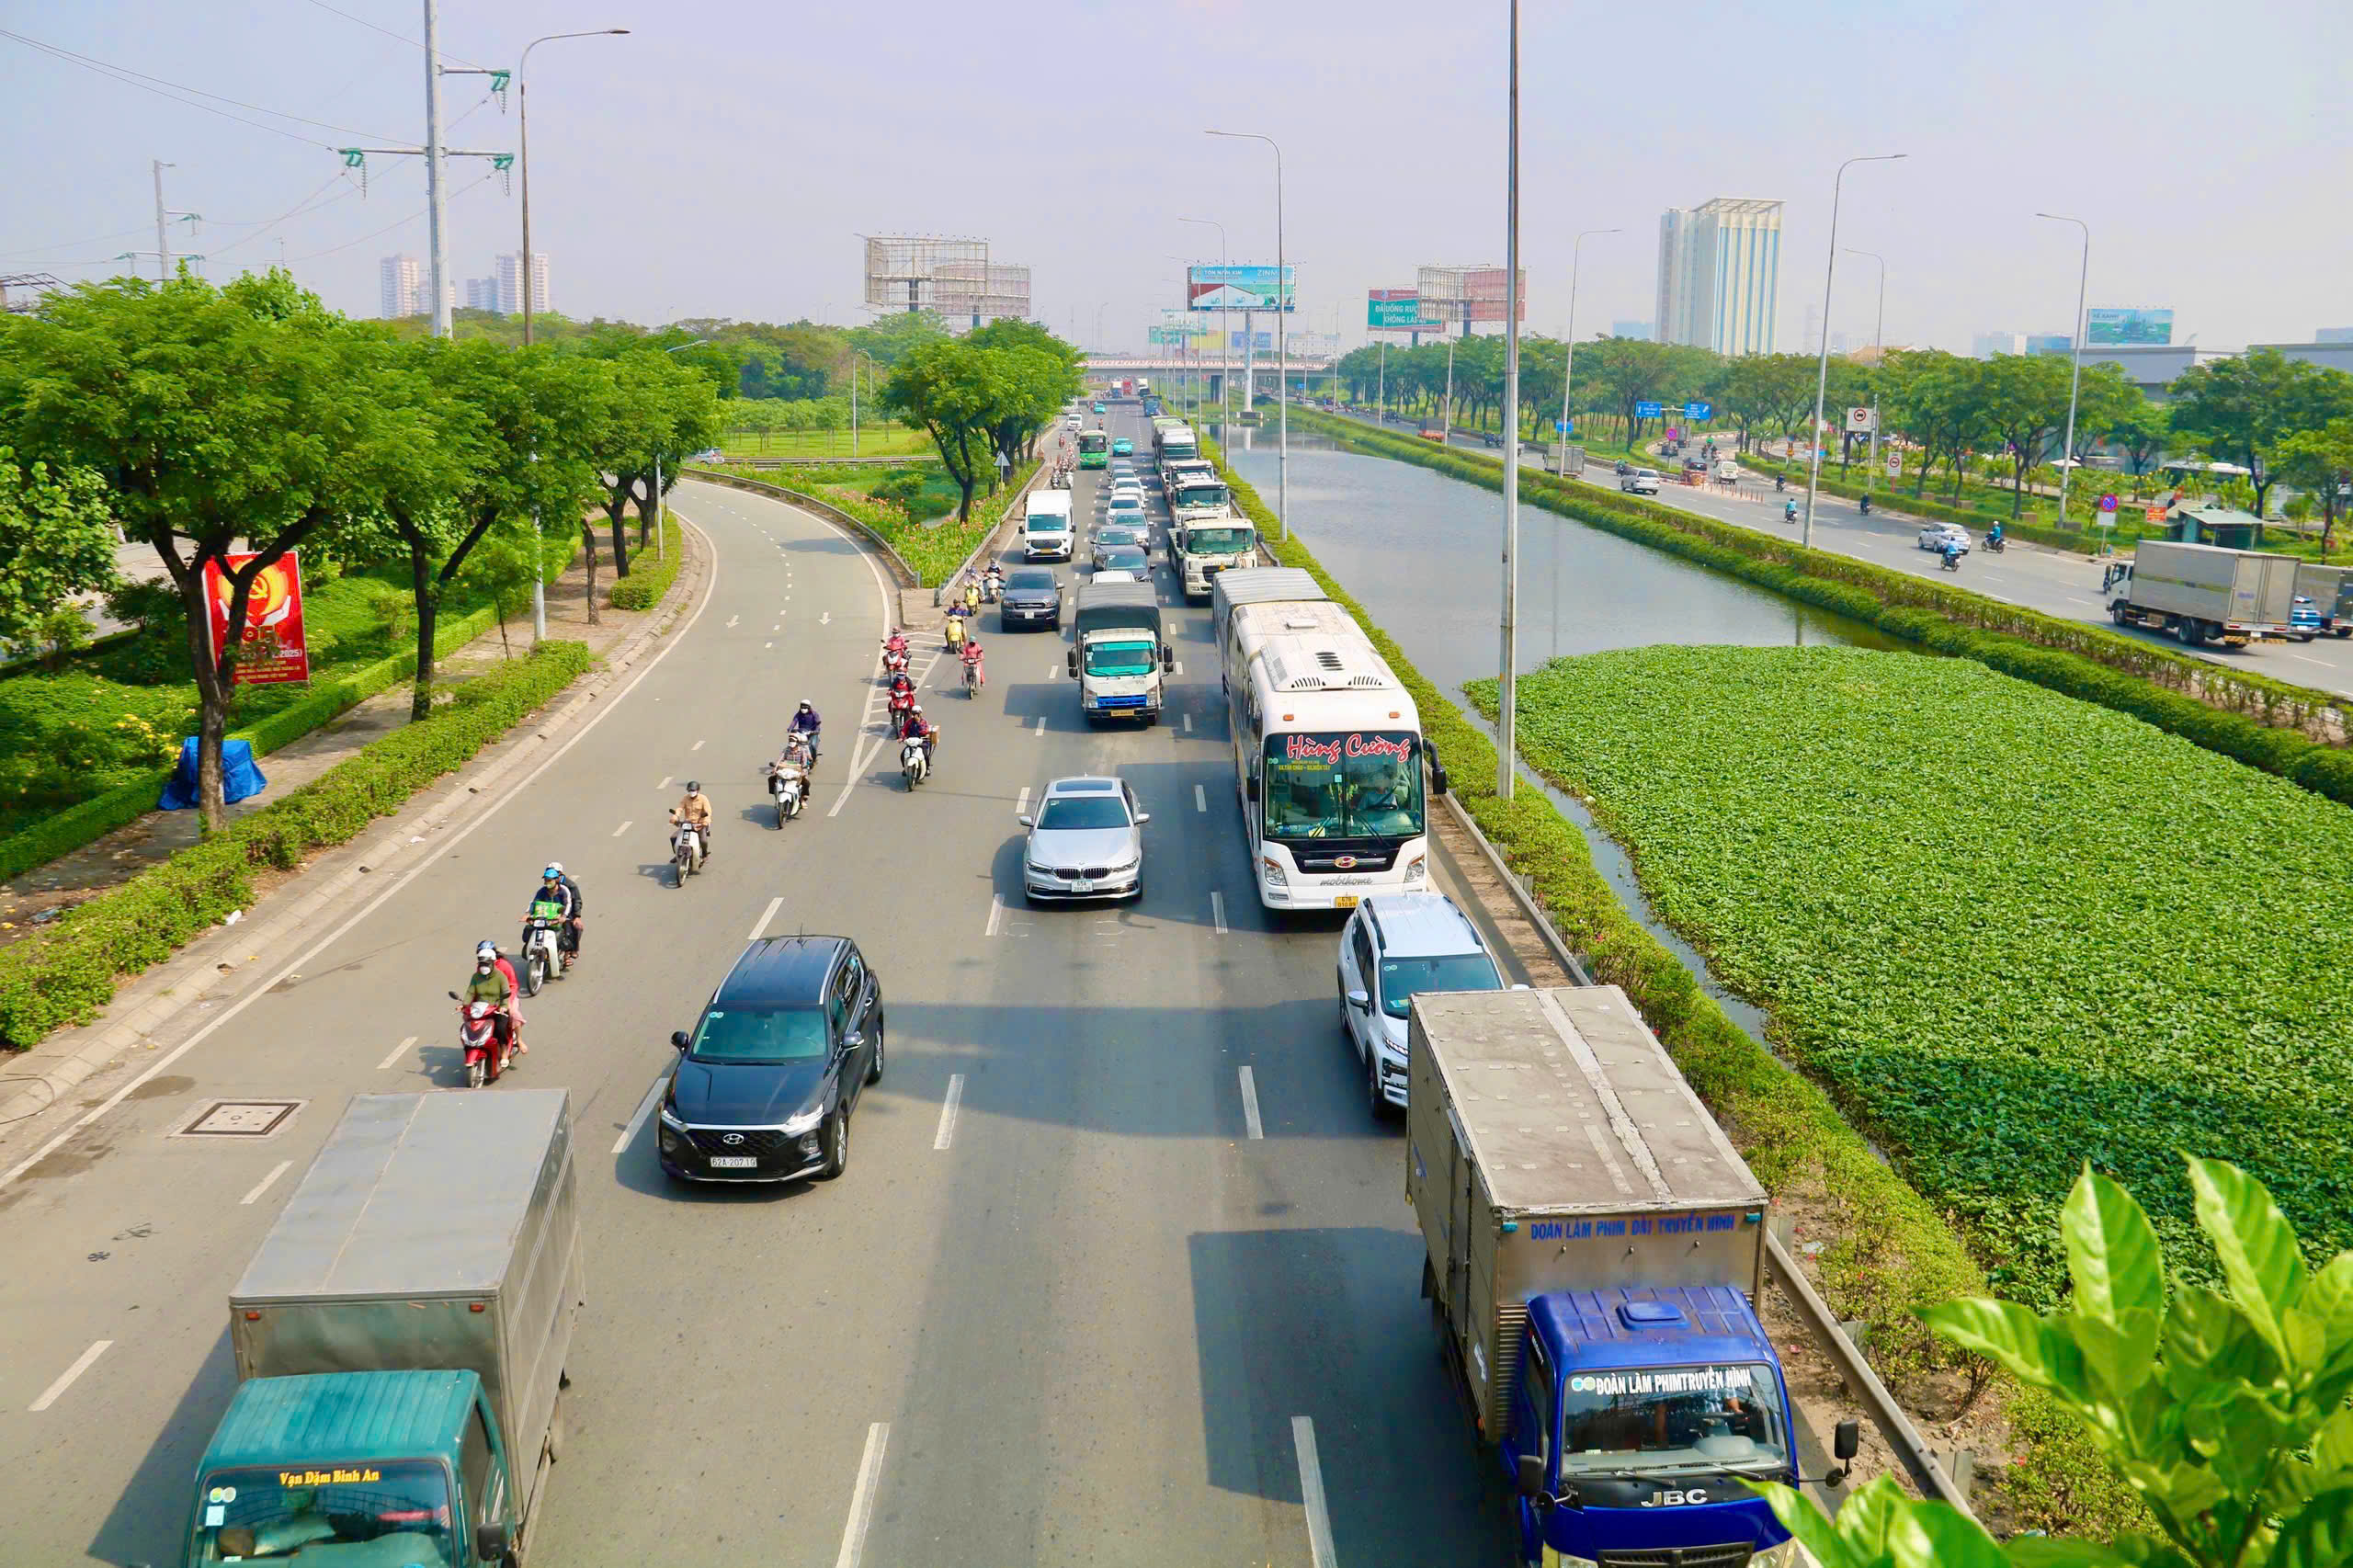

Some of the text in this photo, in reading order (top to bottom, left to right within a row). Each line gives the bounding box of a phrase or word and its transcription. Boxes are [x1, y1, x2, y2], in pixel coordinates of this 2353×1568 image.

[1287, 733, 1411, 764] Hùng Cường
[1596, 1221, 1626, 1236] PHIM
[1596, 1373, 1626, 1395] ĐOÀN
[1628, 1373, 1653, 1393] LÀM
[279, 1472, 302, 1487] Vạn
[1641, 1488, 1708, 1507] JBC
